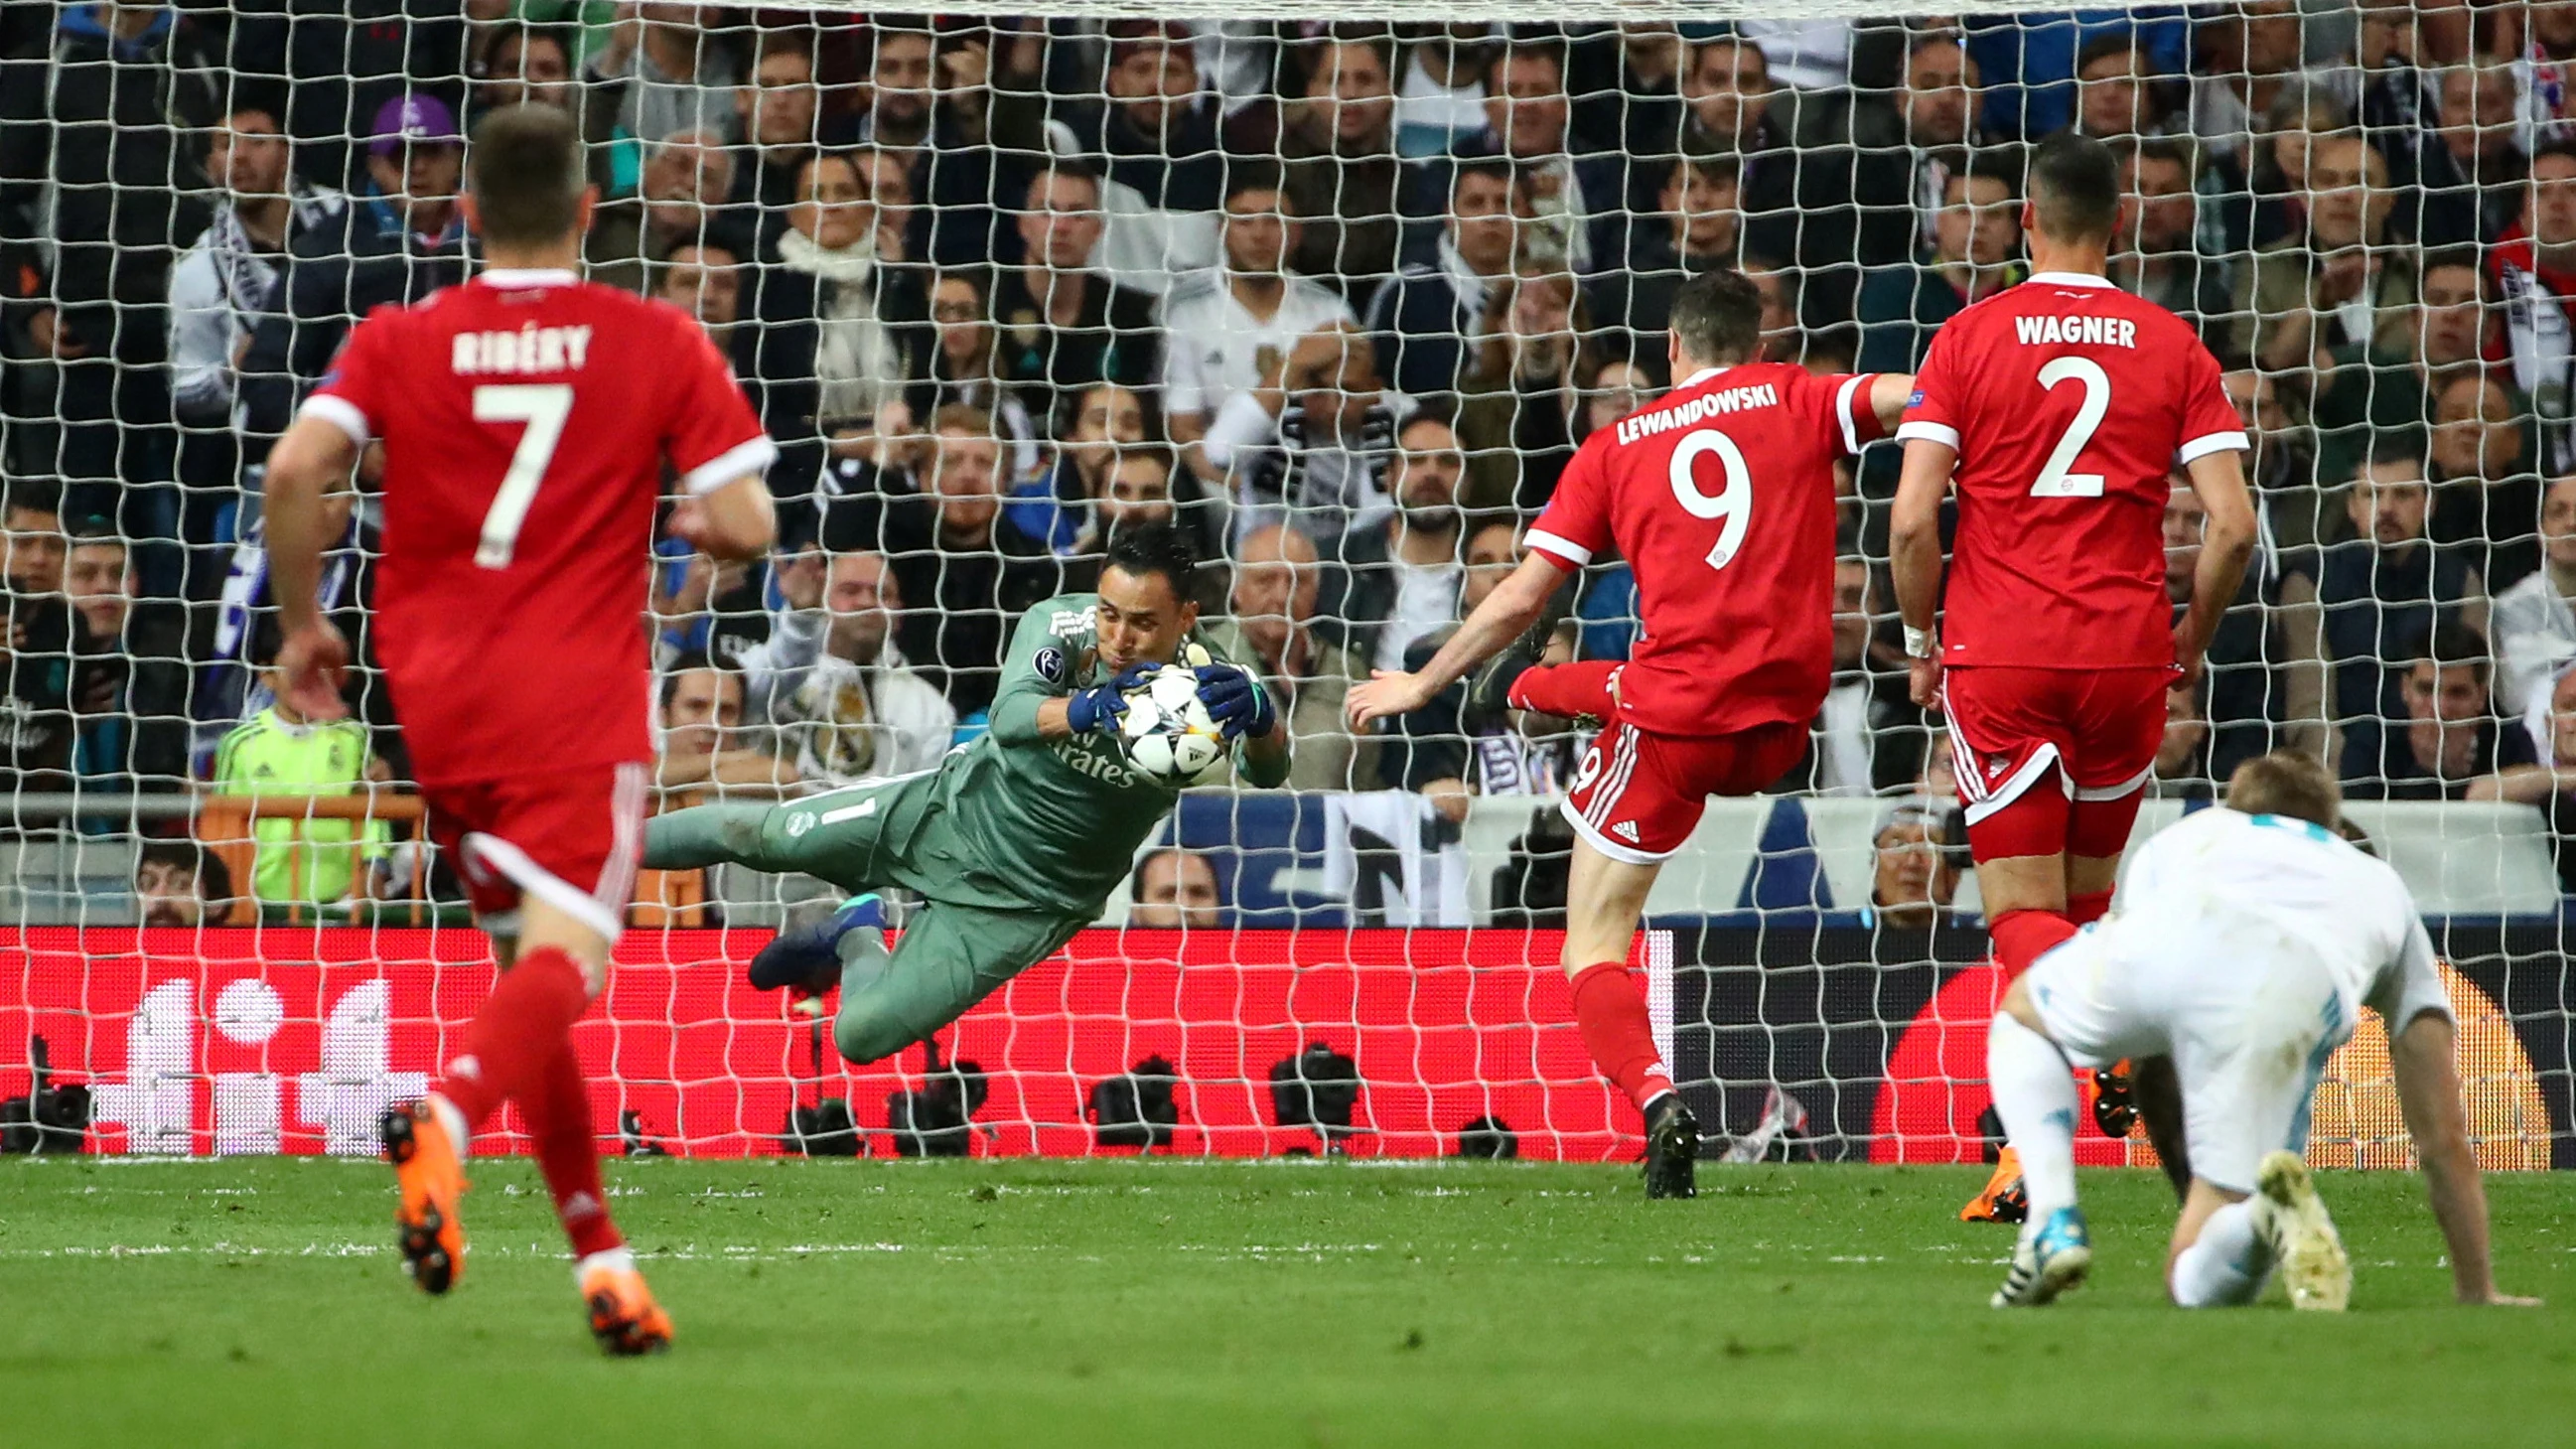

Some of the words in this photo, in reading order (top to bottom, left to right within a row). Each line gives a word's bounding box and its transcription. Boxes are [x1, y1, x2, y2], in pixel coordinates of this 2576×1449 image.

[452, 320, 593, 373] RIBÉRY
[2016, 315, 2137, 349] WAGNER
[1617, 382, 1778, 447] LEWANDOWSKI
[2030, 356, 2112, 498] 2
[472, 383, 576, 570] 7
[1669, 428, 1754, 571] 9
[1575, 746, 1602, 796] 9
[820, 797, 876, 825] 1
